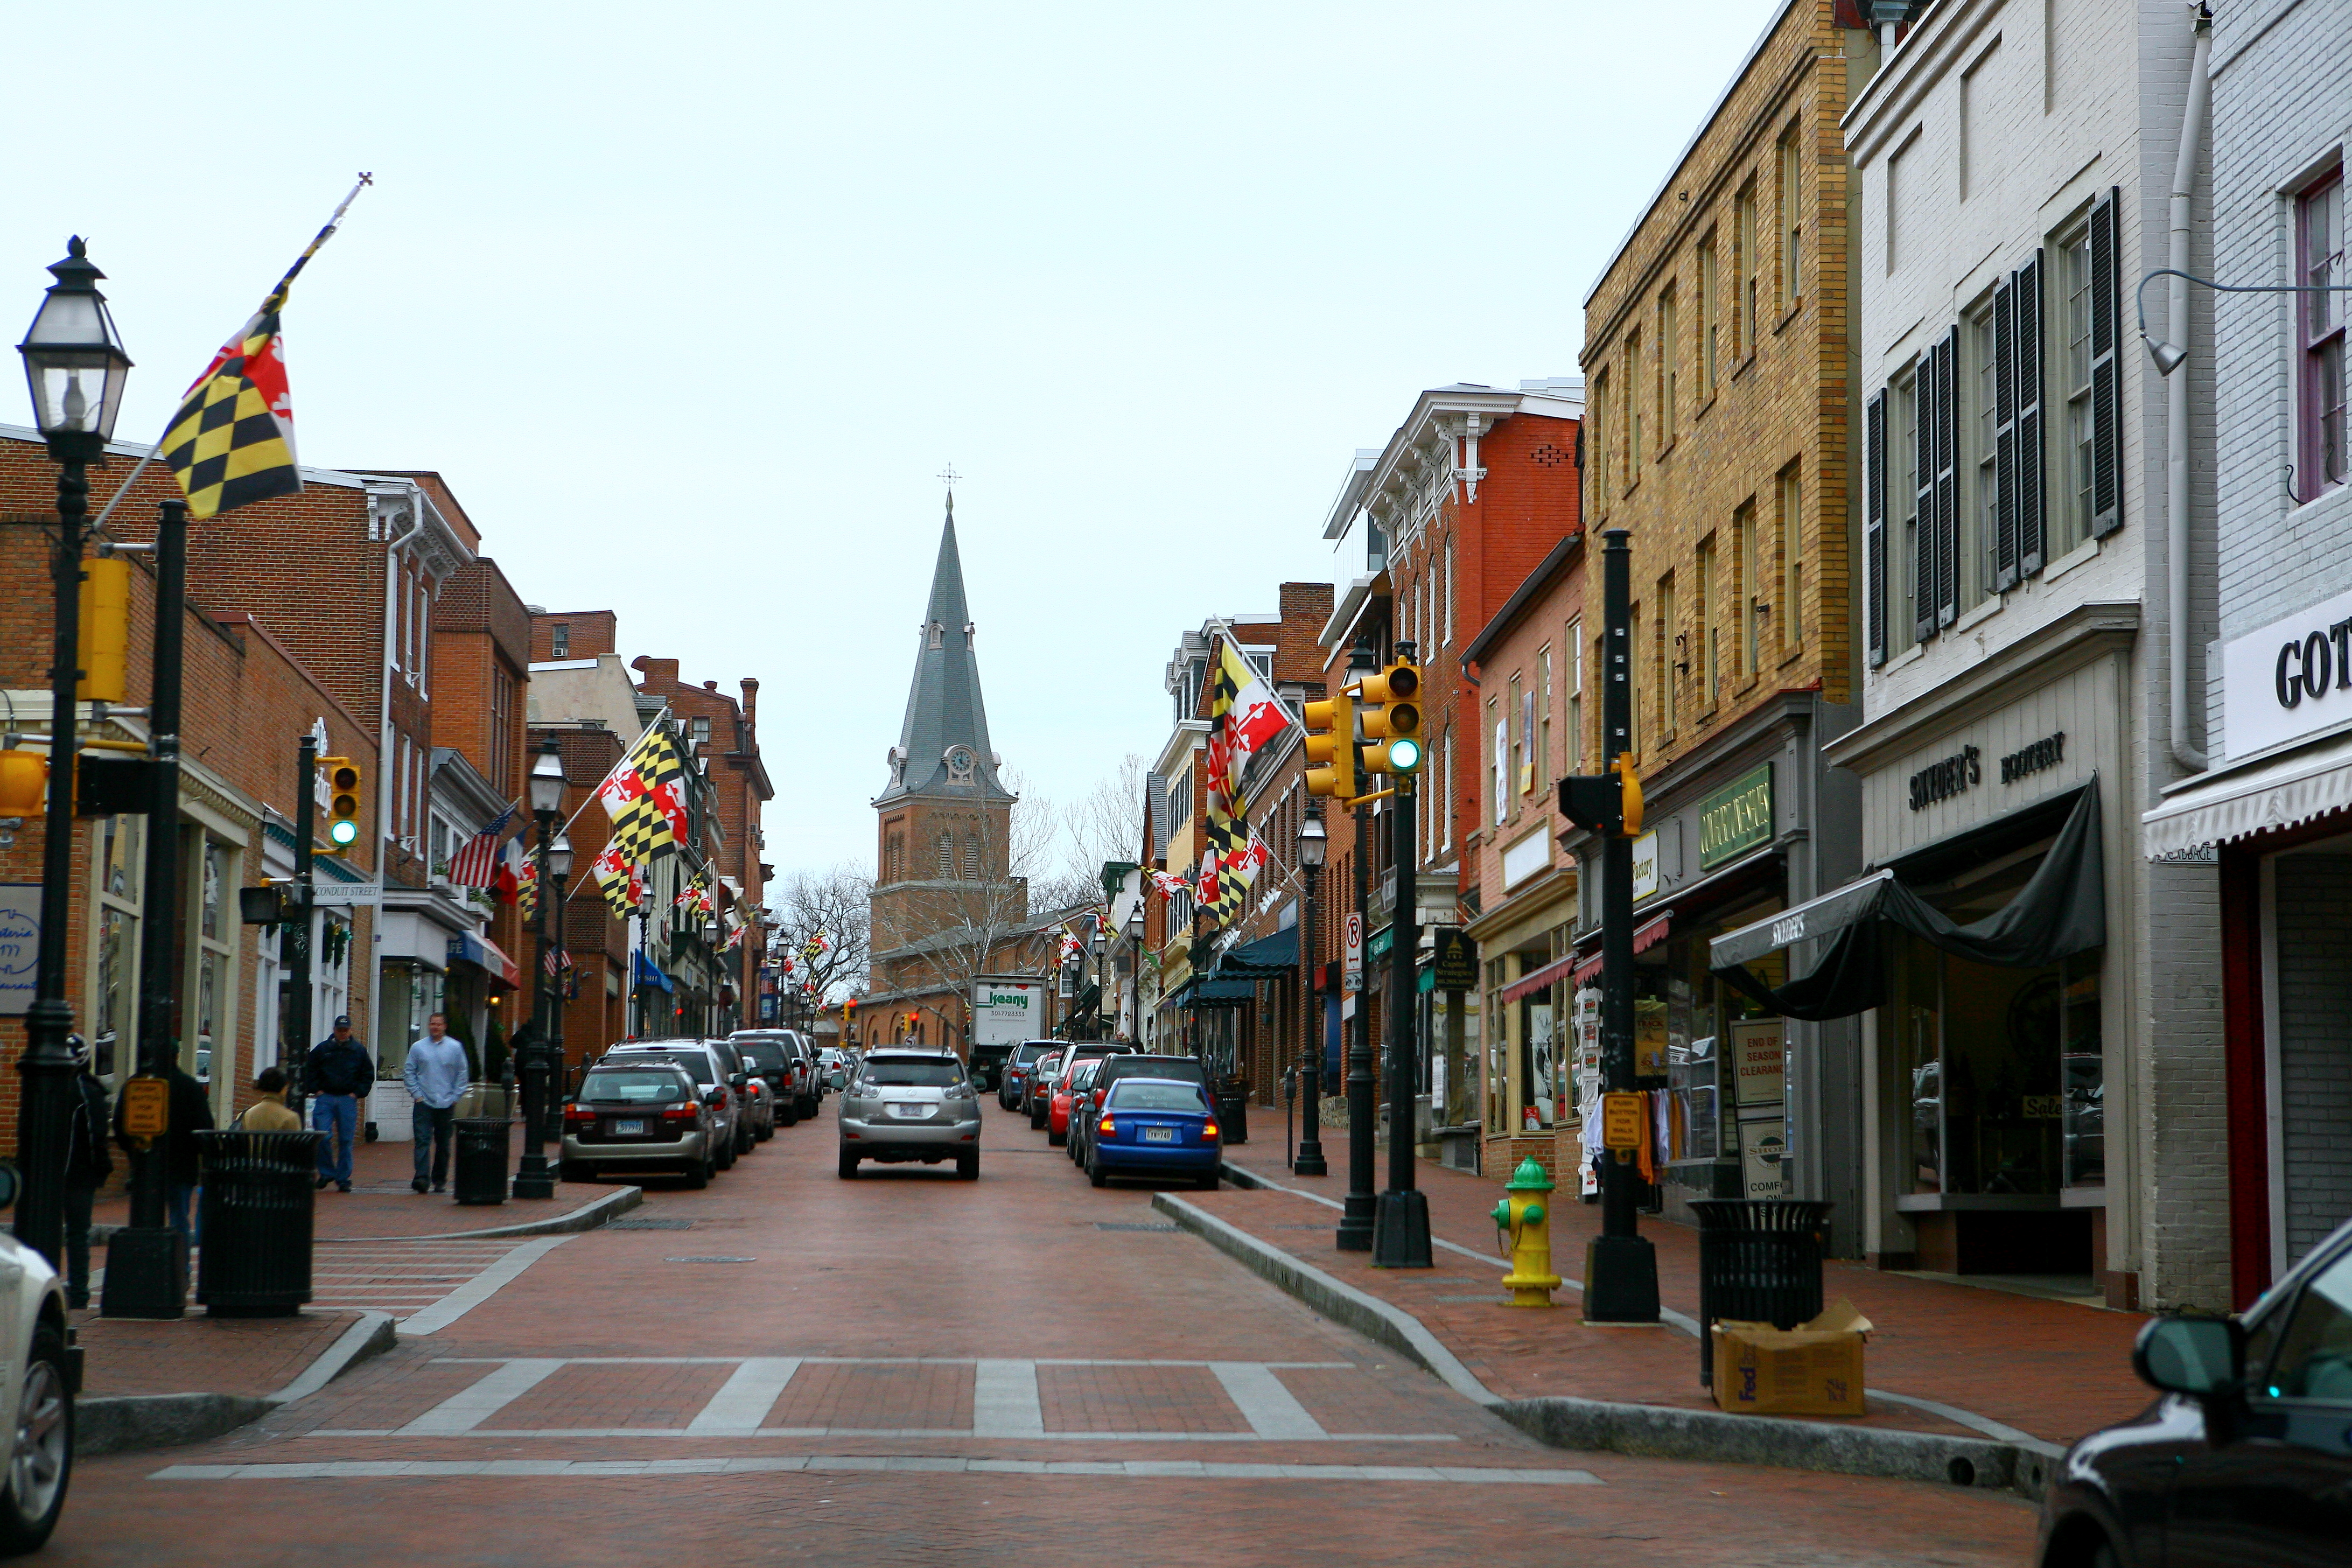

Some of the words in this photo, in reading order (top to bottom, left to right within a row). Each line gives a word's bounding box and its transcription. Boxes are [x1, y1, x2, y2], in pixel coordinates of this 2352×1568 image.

[1909, 744, 1980, 810] SNYDER'S
[2000, 731, 2064, 785] BOOTERY
[316, 886, 349, 896] CONDUIT
[349, 886, 379, 896] STREET
[990, 991, 1028, 1009] keany
[1747, 1038, 1765, 1047] END
[1767, 1037, 1779, 1046] OF
[1746, 1051, 1782, 1061] SEASON
[1740, 1064, 1783, 1076] CLEARANC
[2027, 1098, 2062, 1115] Sale
[1751, 1182, 1782, 1192] COMF
